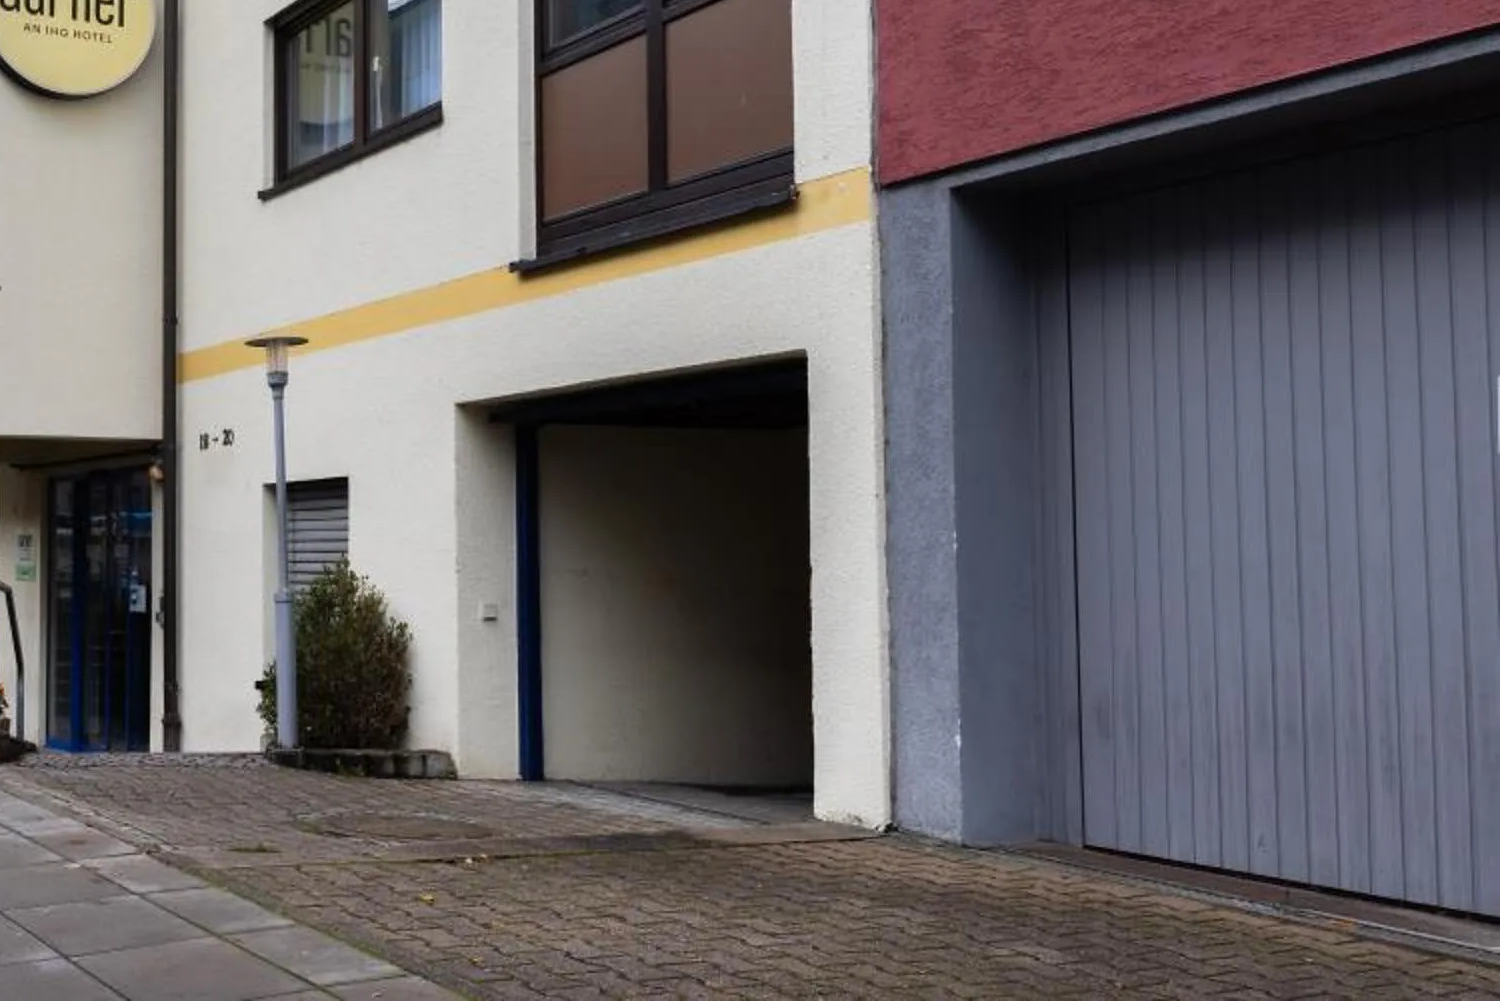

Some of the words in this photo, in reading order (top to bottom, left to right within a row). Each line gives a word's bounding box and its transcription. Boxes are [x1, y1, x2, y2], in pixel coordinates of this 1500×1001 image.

[23, 22, 41, 34] AN
[45, 25, 69, 38] IHG
[73, 29, 113, 44] HOTEL
